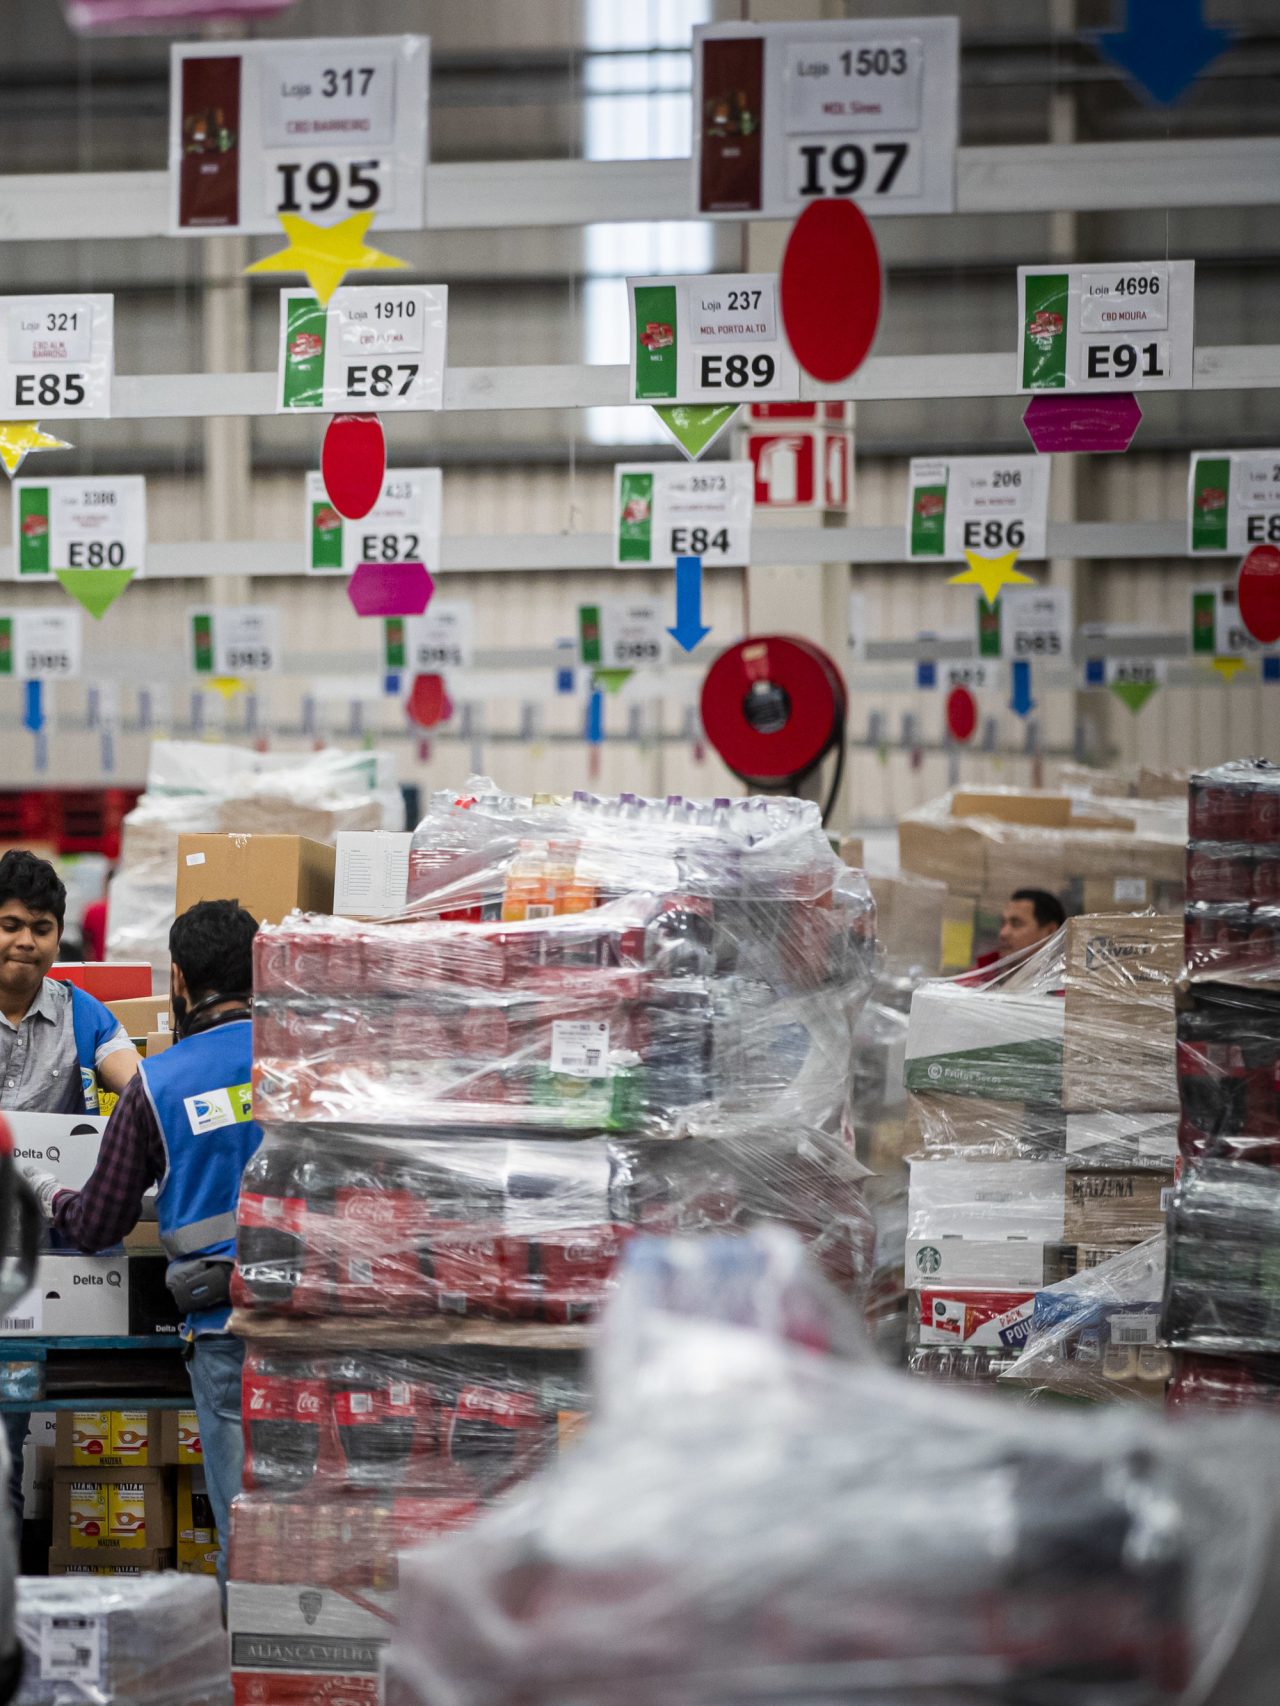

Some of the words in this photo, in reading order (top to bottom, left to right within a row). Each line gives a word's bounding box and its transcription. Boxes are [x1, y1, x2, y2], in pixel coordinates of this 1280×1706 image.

[840, 48, 908, 77] 1503
[320, 68, 375, 97] 317
[797, 142, 910, 196] I97
[276, 159, 381, 214] I95
[1089, 285, 1109, 297] Loja
[1115, 276, 1160, 295] 4696
[349, 310, 368, 321] Loja
[374, 301, 416, 320] 1910
[701, 301, 721, 313] Loja
[727, 291, 762, 311] 237
[46, 313, 79, 331] 321
[700, 325, 716, 335] MDL
[718, 325, 743, 335] PORTO
[745, 323, 766, 333] ALTO
[1101, 312, 1117, 322] CBD
[1119, 311, 1147, 321] MOURA
[700, 354, 776, 389] E89
[1087, 343, 1164, 379] E91
[15, 373, 85, 406] E85
[347, 364, 419, 397] E87
[991, 469, 1022, 488] 206
[362, 534, 419, 561] E82
[670, 527, 730, 555] E84
[962, 520, 1024, 549] E86
[68, 541, 125, 568] E80
[13, 1148, 43, 1159] Delta
[46, 1146, 60, 1163] Q
[73, 1274, 103, 1285] Delta
[106, 1270, 121, 1288] Q
[155, 1324, 176, 1333] Delta
[248, 1644, 316, 1661] ALIANÇA
[317, 1646, 376, 1661] VELHA
